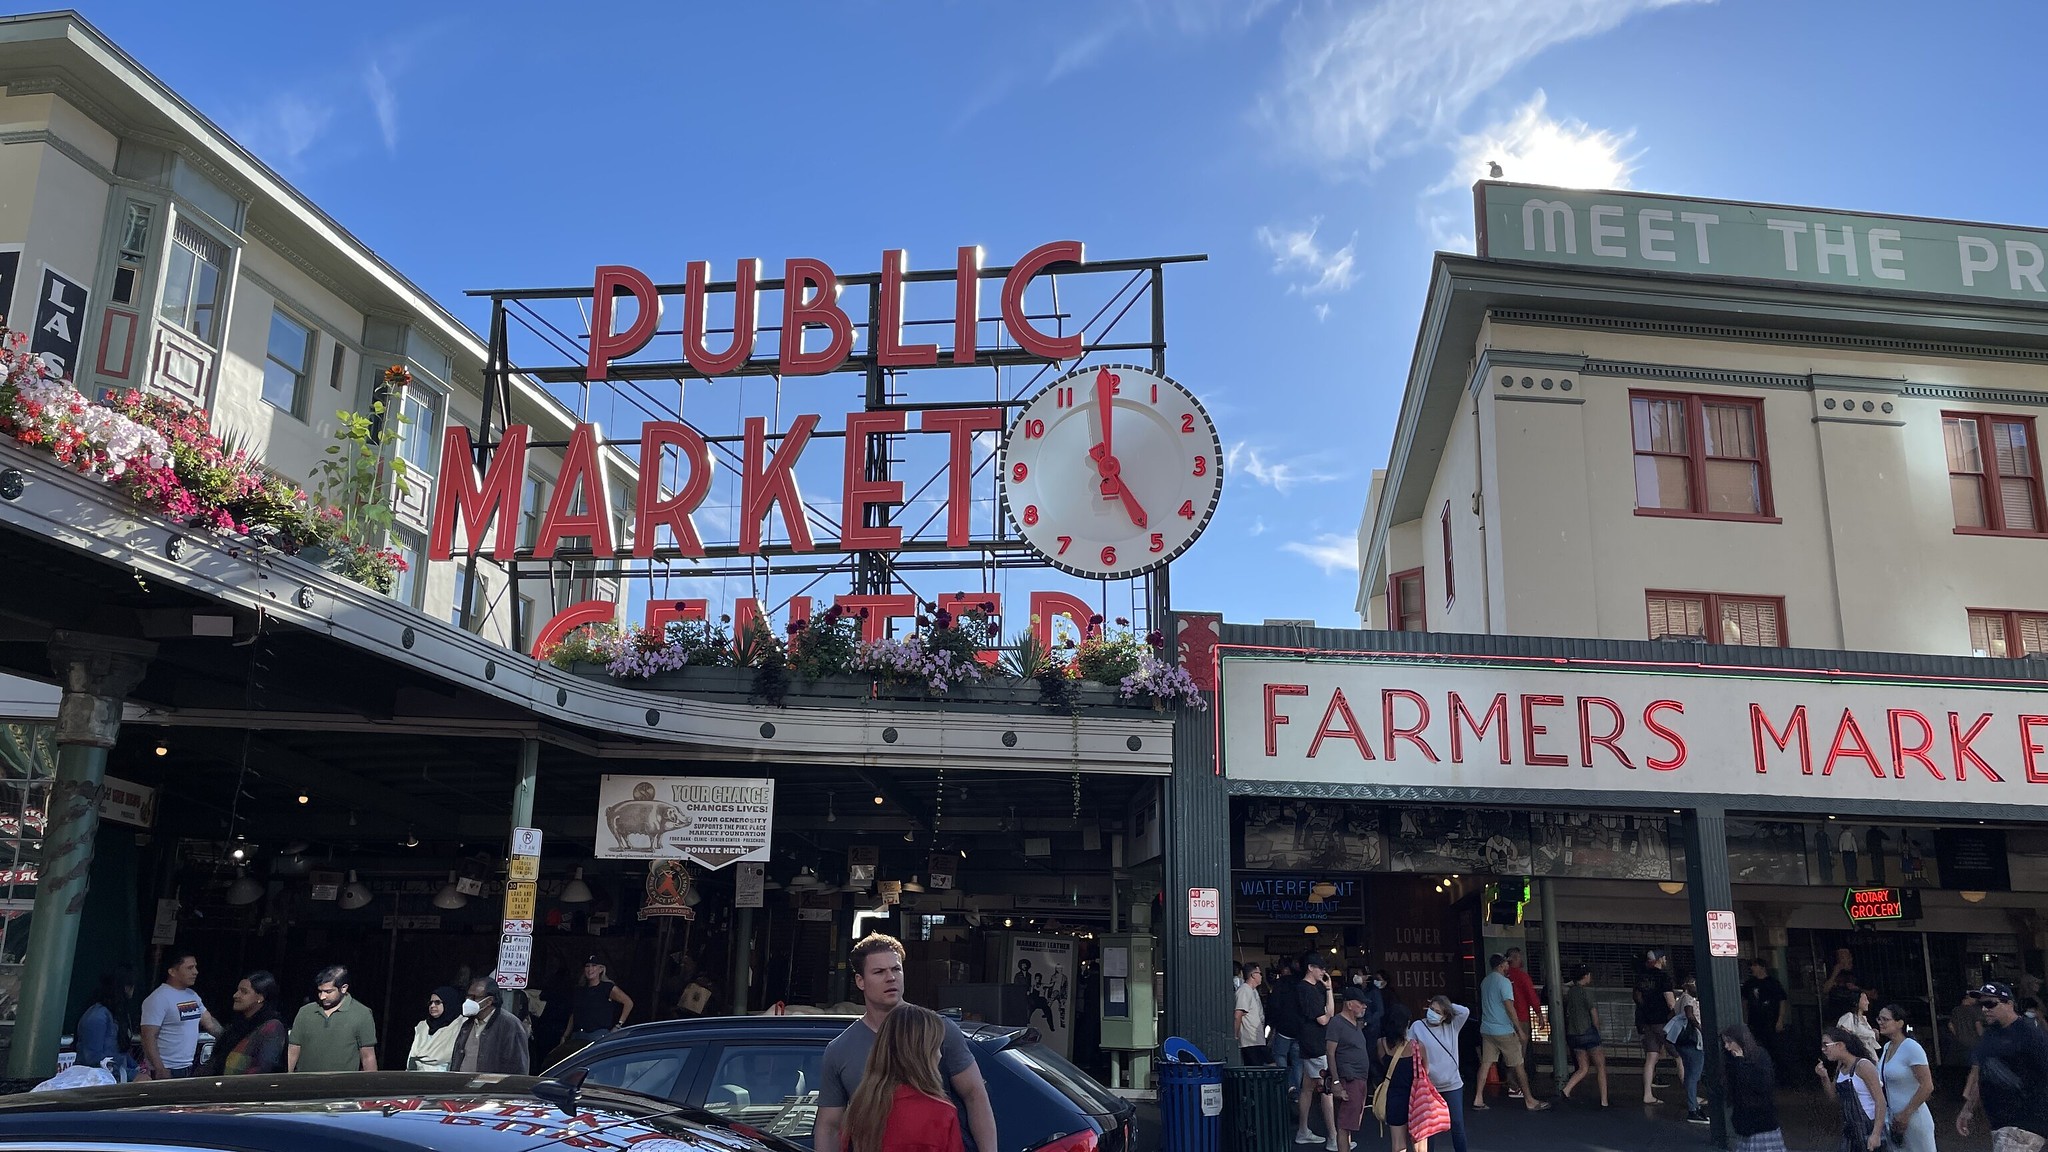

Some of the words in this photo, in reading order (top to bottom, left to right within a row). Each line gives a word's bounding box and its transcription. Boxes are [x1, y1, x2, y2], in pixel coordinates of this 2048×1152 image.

[1522, 198, 1720, 264] MEET
[1767, 218, 1906, 281] THE
[586, 240, 1087, 380] PUBLIC
[1058, 387, 1073, 408] 11
[1151, 384, 1157, 404] 1
[1025, 419, 1045, 439] 10
[1180, 413, 1195, 433] 2
[1012, 462, 1028, 483] 9
[1193, 456, 1207, 477] 3
[429, 406, 1004, 560] MARKET
[1023, 505, 1039, 526] 8
[1178, 500, 1196, 520] 4
[1057, 536, 1073, 555] 7
[1149, 533, 1164, 552] 5
[1101, 546, 1117, 566] 6
[1262, 683, 1688, 772] FARMERS
[672, 785, 711, 802] YOUR
[712, 786, 769, 804] CHANGE
[687, 804, 734, 812] CHANGES
[736, 805, 768, 813] LIVES!
[1240, 880, 1354, 896] WATERFNT
[1855, 890, 1888, 903] ROTARY
[1257, 900, 1340, 912] VIEWPOINT
[1851, 902, 1900, 918] GROCERY
[1396, 928, 1441, 944] LOWER
[1711, 922, 1732, 930] STOPS
[1384, 951, 1455, 962] MARKET
[1396, 970, 1446, 987] LEVELS
